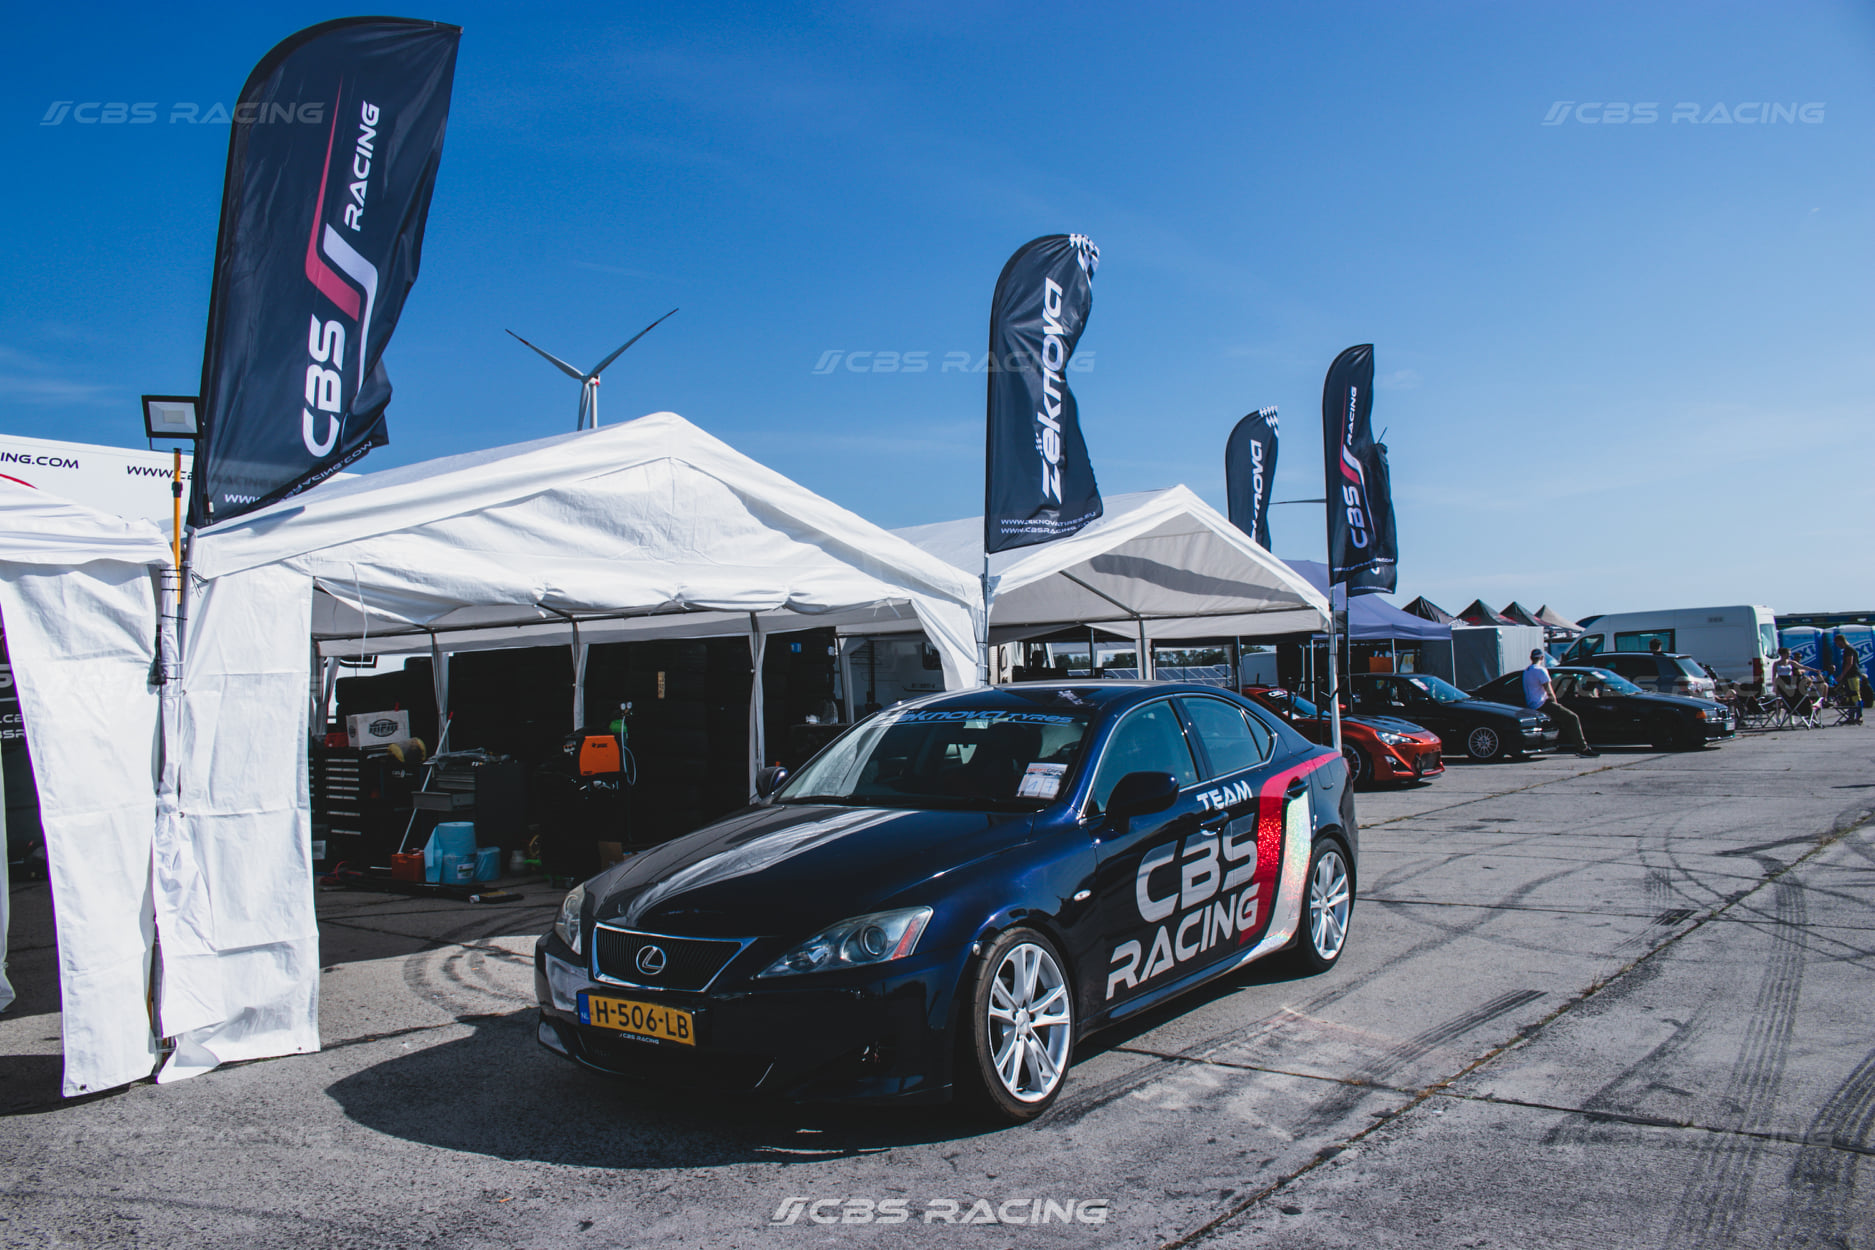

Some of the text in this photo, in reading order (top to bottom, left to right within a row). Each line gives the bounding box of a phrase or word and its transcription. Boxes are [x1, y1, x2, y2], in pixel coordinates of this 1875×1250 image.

[344, 100, 380, 231] RACING
[303, 313, 346, 457] CBS
[1346, 386, 1358, 446] RACING
[1342, 485, 1368, 549] CBS
[1196, 780, 1253, 812] TEAM
[1136, 812, 1259, 923] CBS
[1105, 882, 1261, 1001] RACING
[595, 999, 690, 1039] H-506-LB
